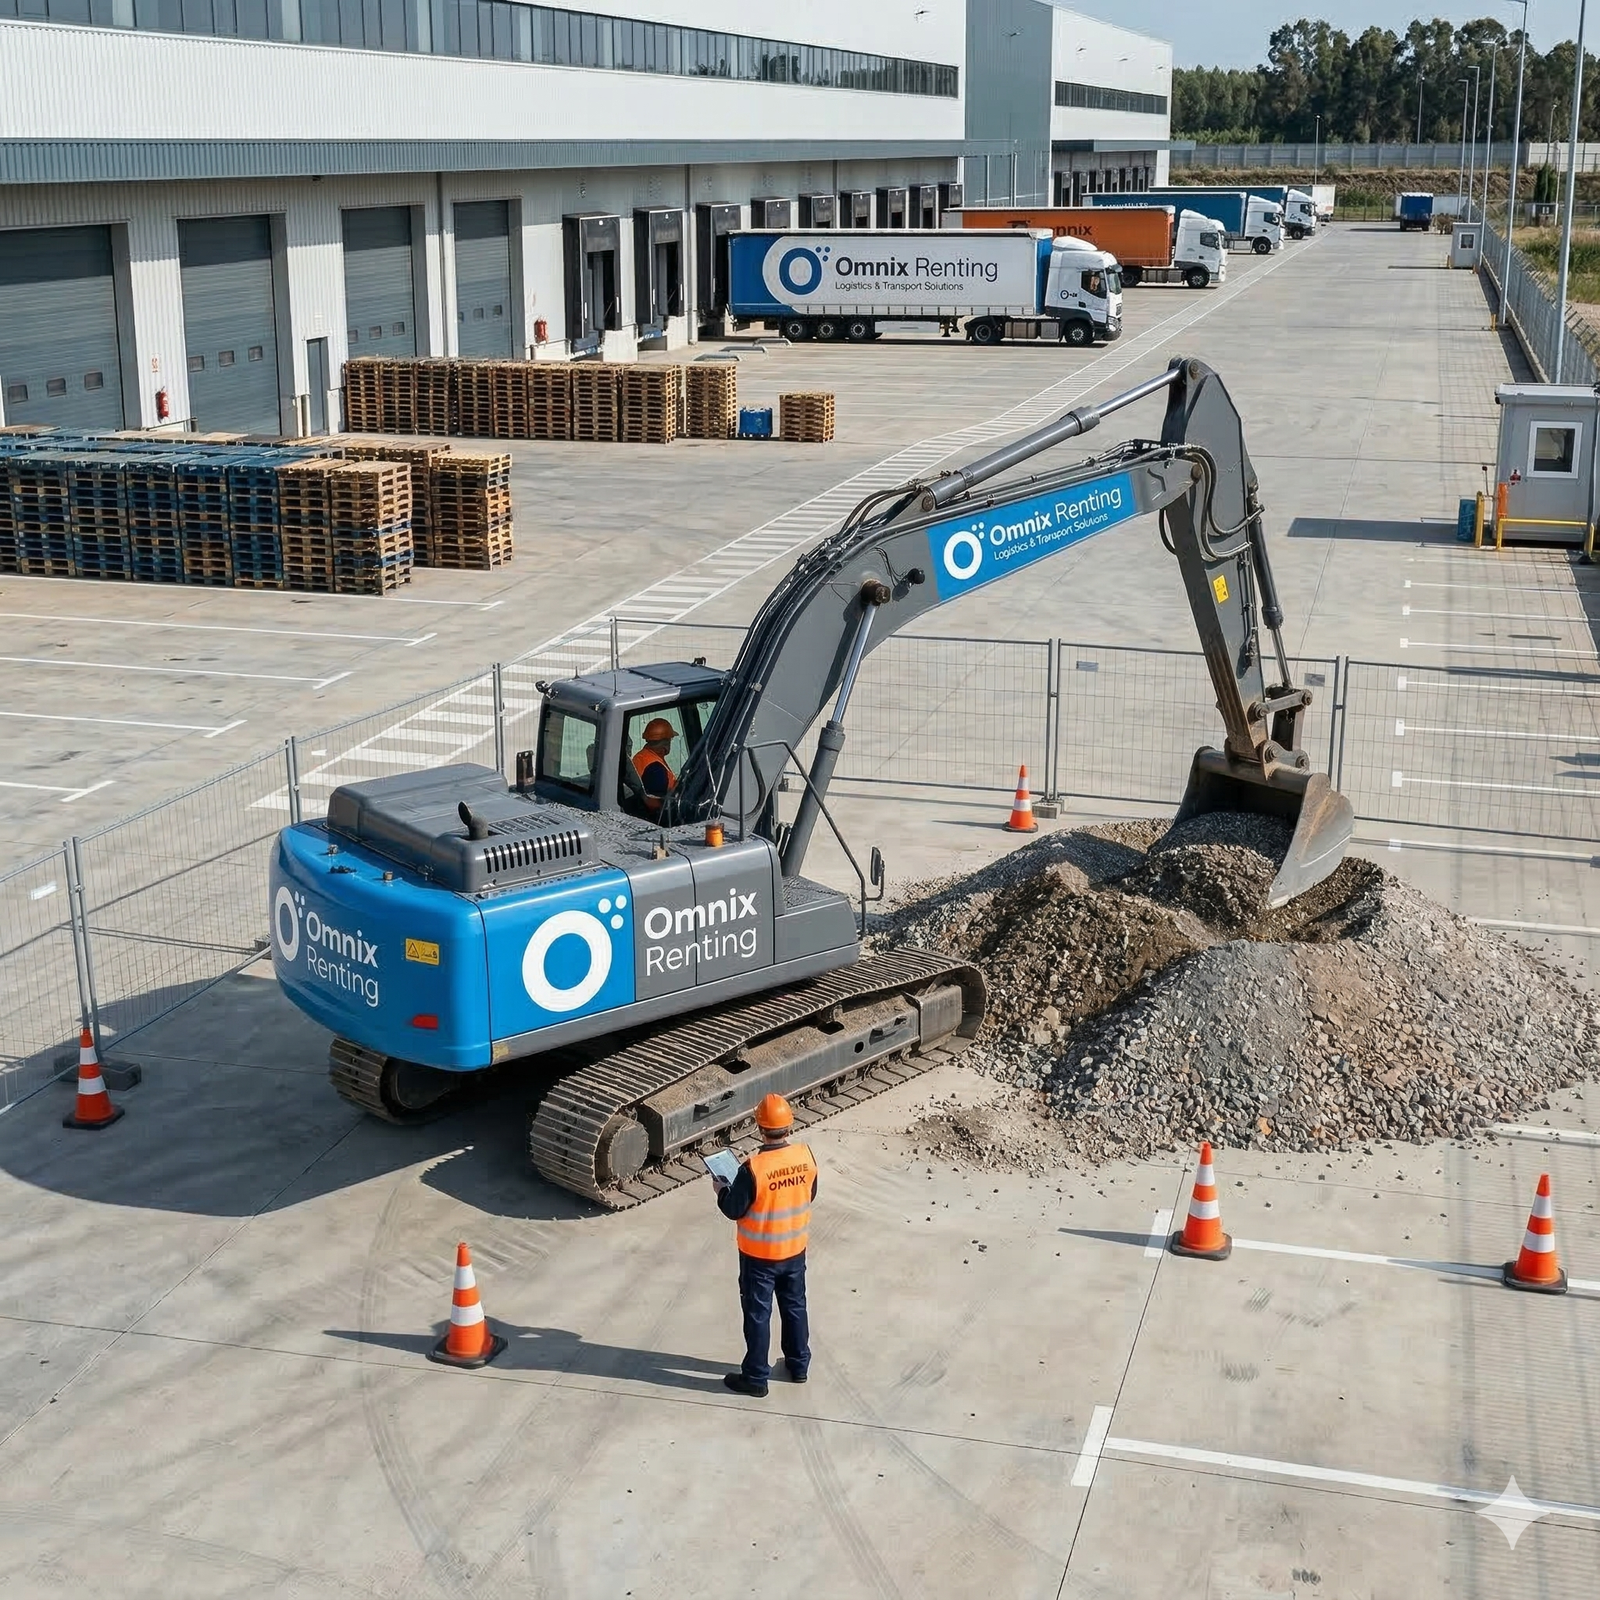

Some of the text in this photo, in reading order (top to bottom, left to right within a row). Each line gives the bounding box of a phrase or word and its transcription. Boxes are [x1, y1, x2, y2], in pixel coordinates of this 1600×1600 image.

[835, 256, 998, 282] Omnix Renting
[835, 281, 872, 292] Logistics
[875, 281, 880, 290] &
[882, 281, 922, 292] Transport
[989, 488, 1122, 546] Omnix Renting
[993, 541, 1029, 560] Logistics
[1029, 537, 1036, 548] &
[644, 887, 758, 940] Omnix
[306, 911, 379, 968] Omnix
[646, 927, 757, 976] Renting
[306, 944, 379, 1008] Renting
[769, 1174, 806, 1191] OMNIX
